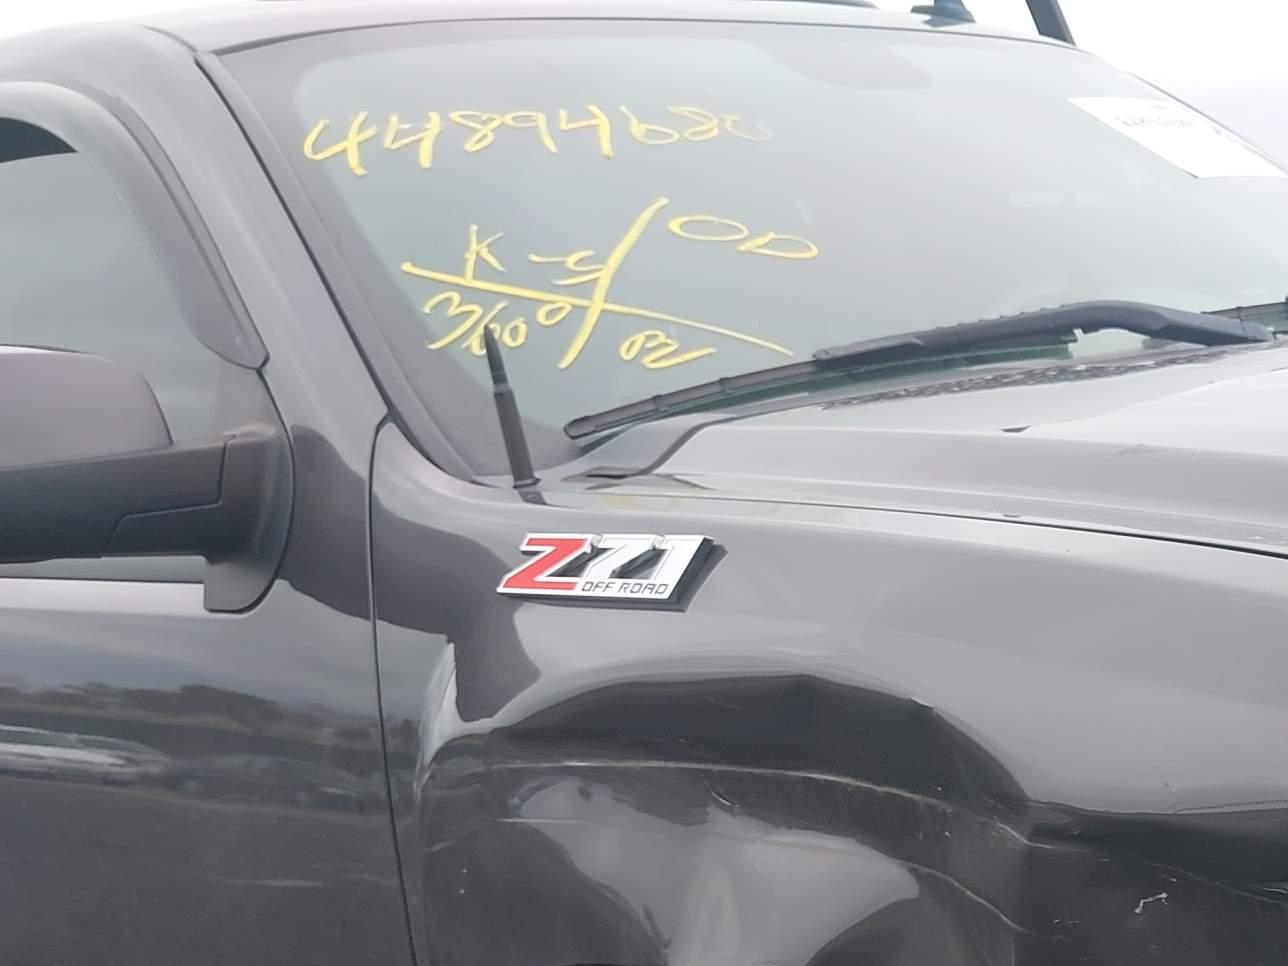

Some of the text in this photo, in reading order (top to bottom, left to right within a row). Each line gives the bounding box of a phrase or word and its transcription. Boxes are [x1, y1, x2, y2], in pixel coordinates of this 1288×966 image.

[302, 106, 774, 176] 44894680
[497, 533, 712, 598] Z71
[581, 581, 670, 595] OFF ROAD
